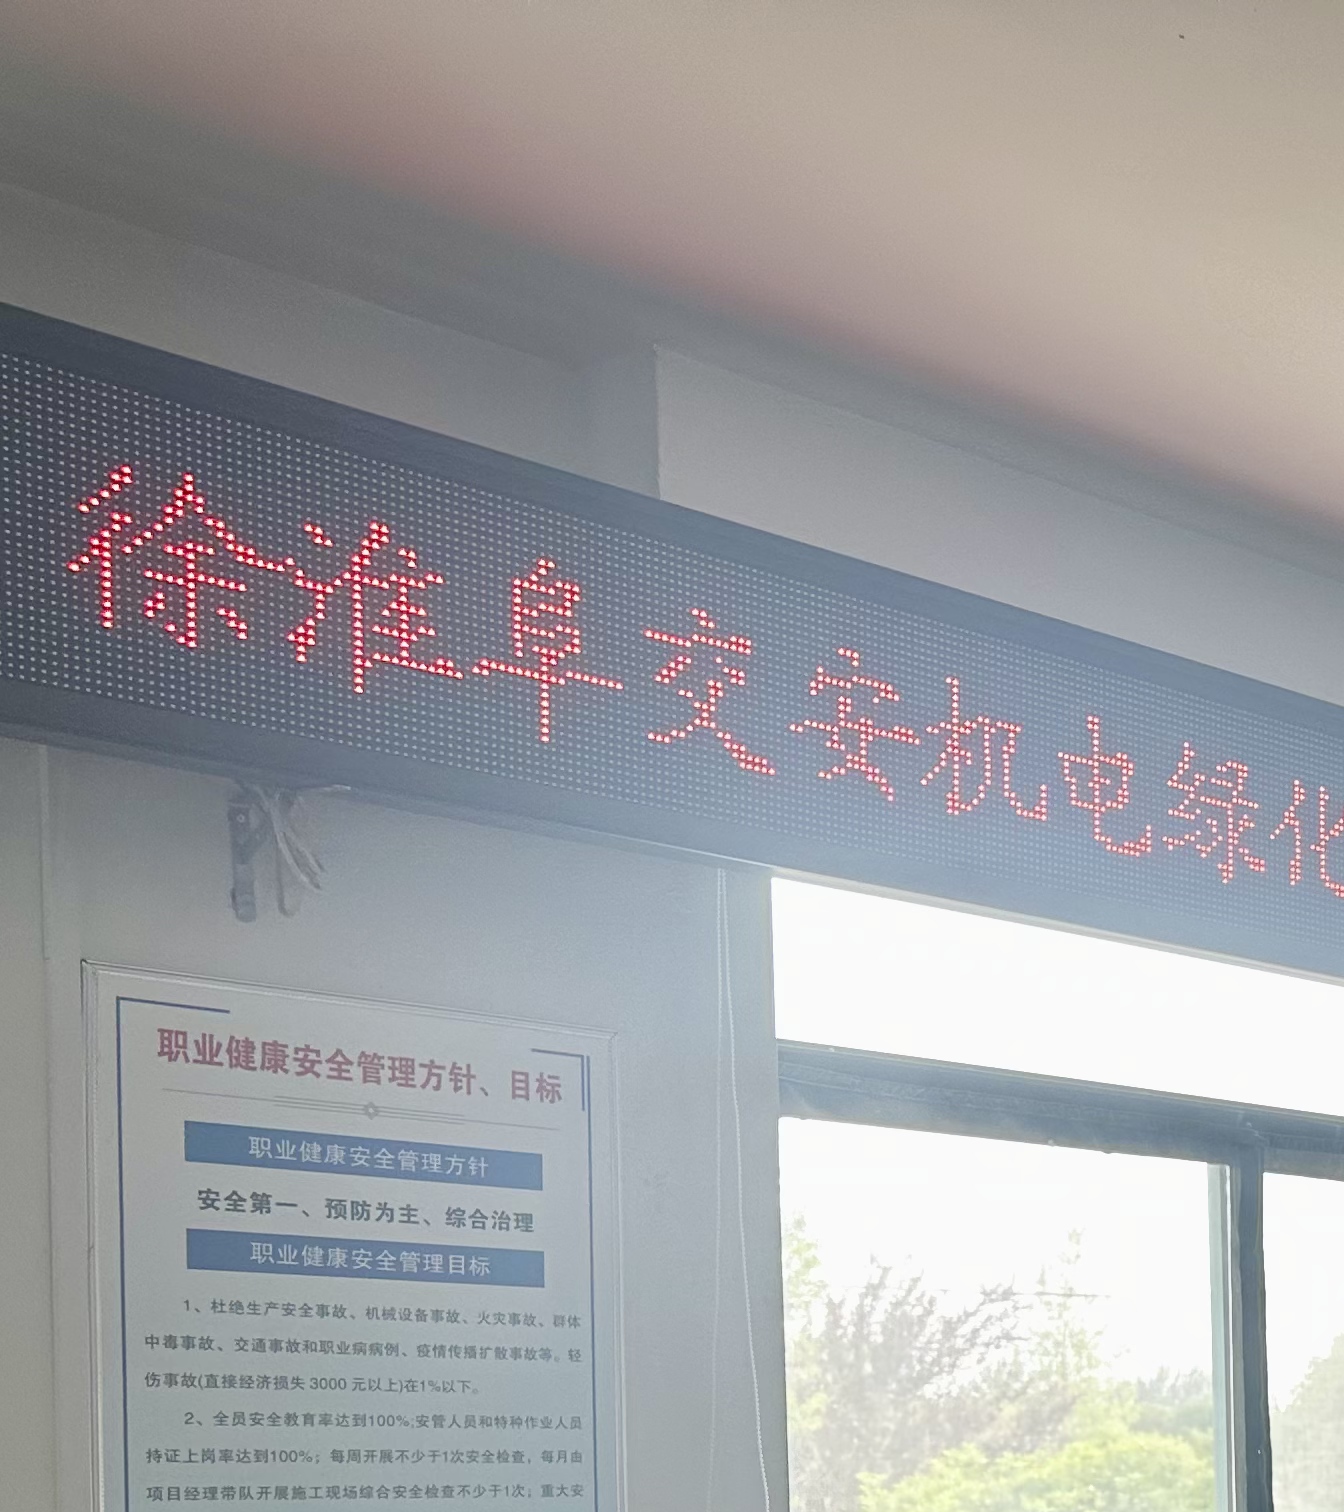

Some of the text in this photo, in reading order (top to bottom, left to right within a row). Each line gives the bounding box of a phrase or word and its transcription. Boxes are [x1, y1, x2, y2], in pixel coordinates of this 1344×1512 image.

[156, 1027, 564, 1105] 职业健康安全管理方针、目标
[248, 1135, 490, 1179] 职业健康安全管理方针
[197, 1187, 535, 1233] 安全第一、预防为主、综合治理
[250, 1241, 491, 1277] 职业健康安全管理目标
[183, 1297, 582, 1330] 1、杜绝生产安全事故、机械设备事故、火灾事故、群体
